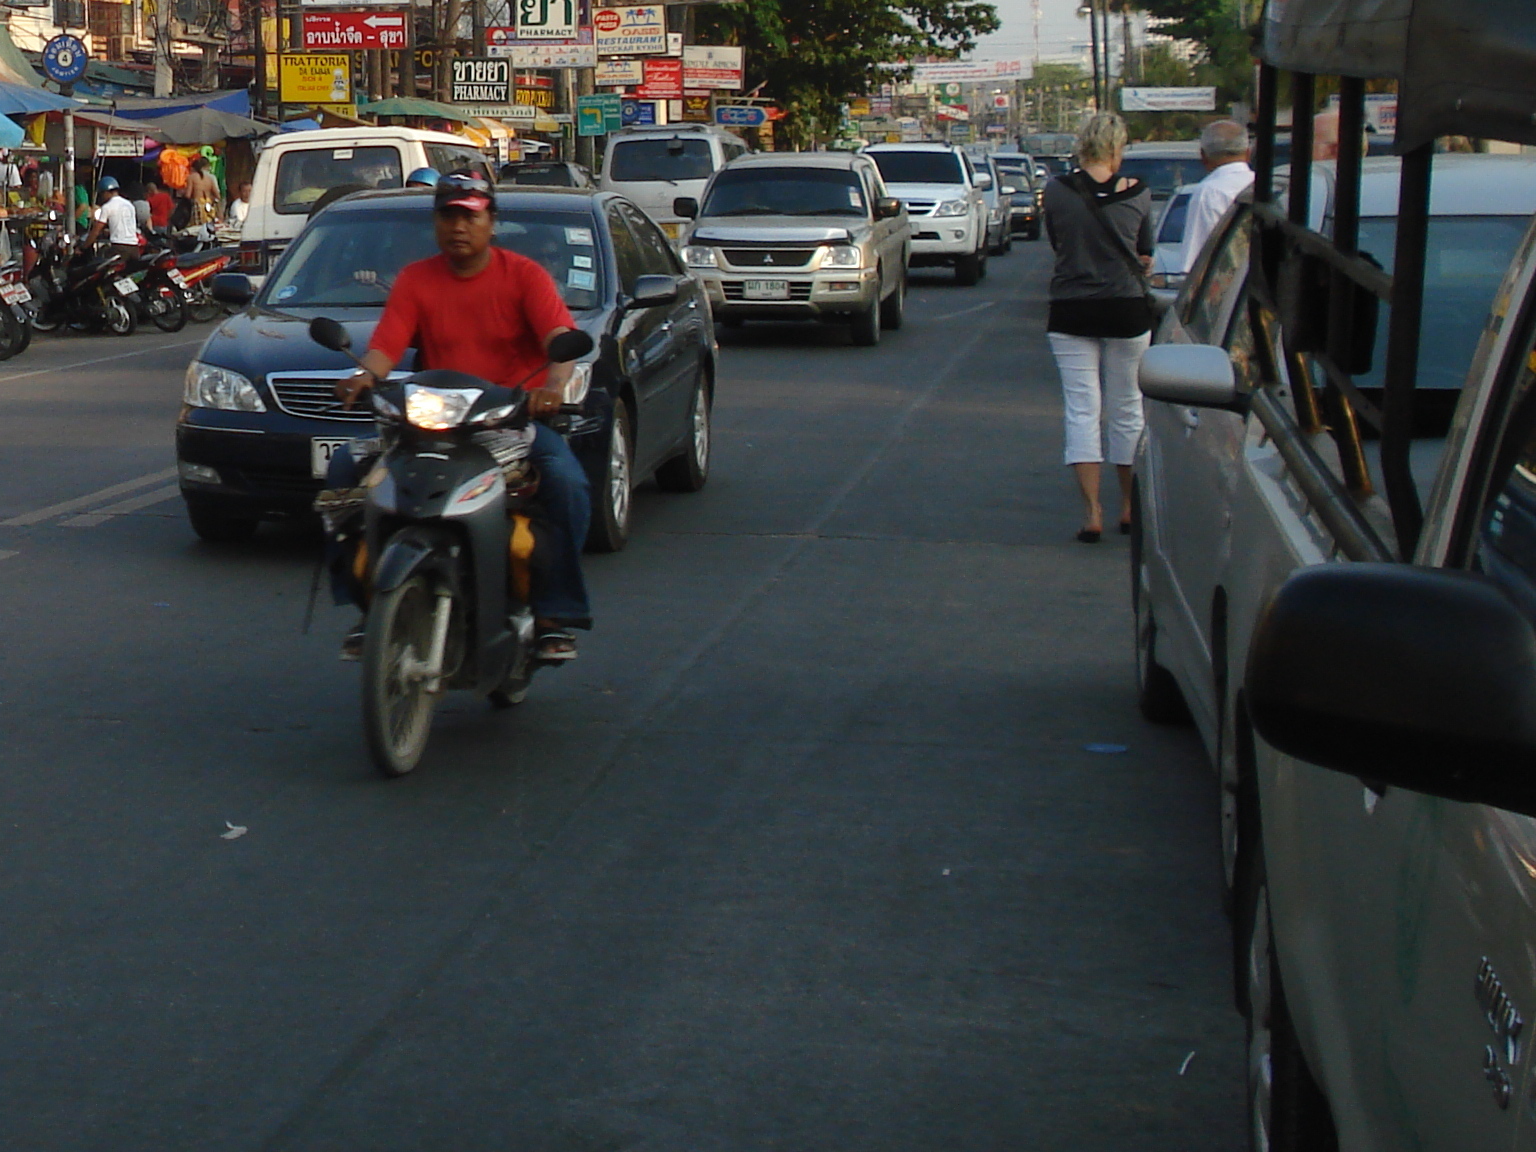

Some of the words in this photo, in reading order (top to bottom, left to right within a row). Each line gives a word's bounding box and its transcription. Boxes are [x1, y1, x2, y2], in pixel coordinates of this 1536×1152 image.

[519, 28, 573, 36] PHARMACY
[621, 28, 660, 36] OASIS
[597, 36, 663, 46] RESTAURANT
[61, 54, 68, 63] 4
[283, 56, 347, 67] TRATTORIA
[453, 61, 508, 82] ขายยา
[453, 85, 507, 101] PHARMACY
